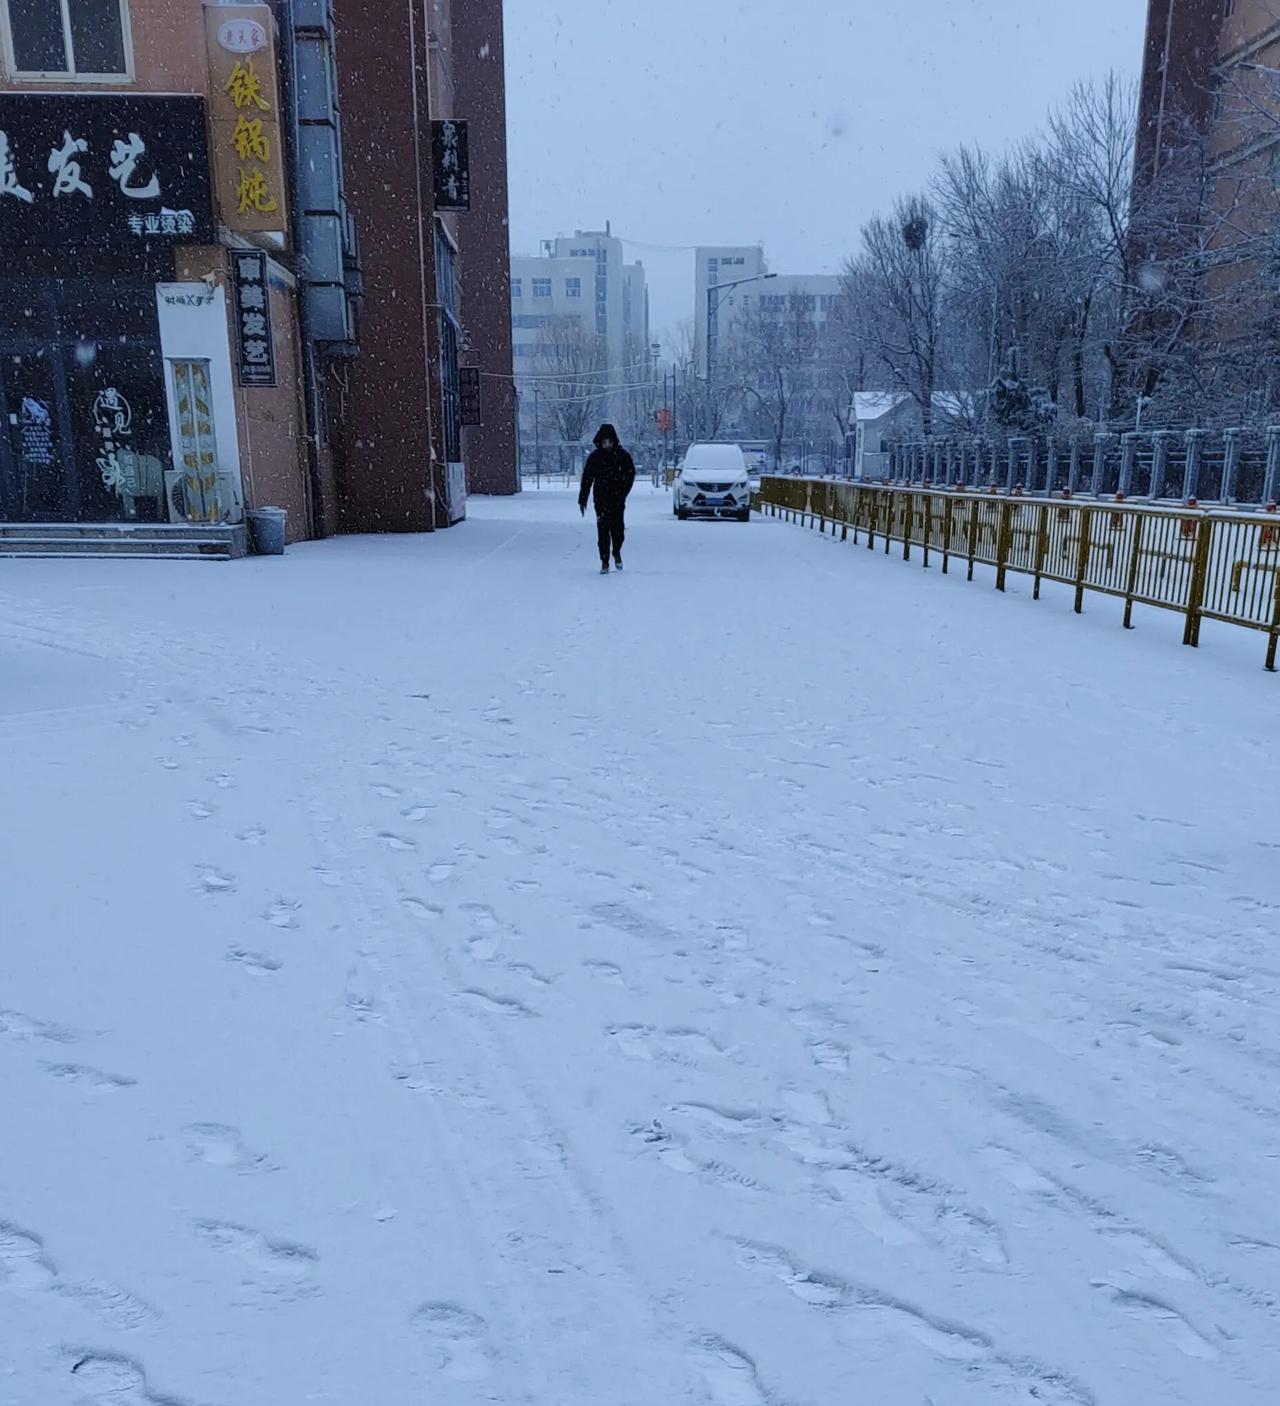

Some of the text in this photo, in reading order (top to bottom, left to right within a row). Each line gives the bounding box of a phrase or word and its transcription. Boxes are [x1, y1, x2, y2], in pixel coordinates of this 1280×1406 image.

[224, 60, 277, 214] 铁锅炖
[127, 212, 193, 237] 专业烫染
